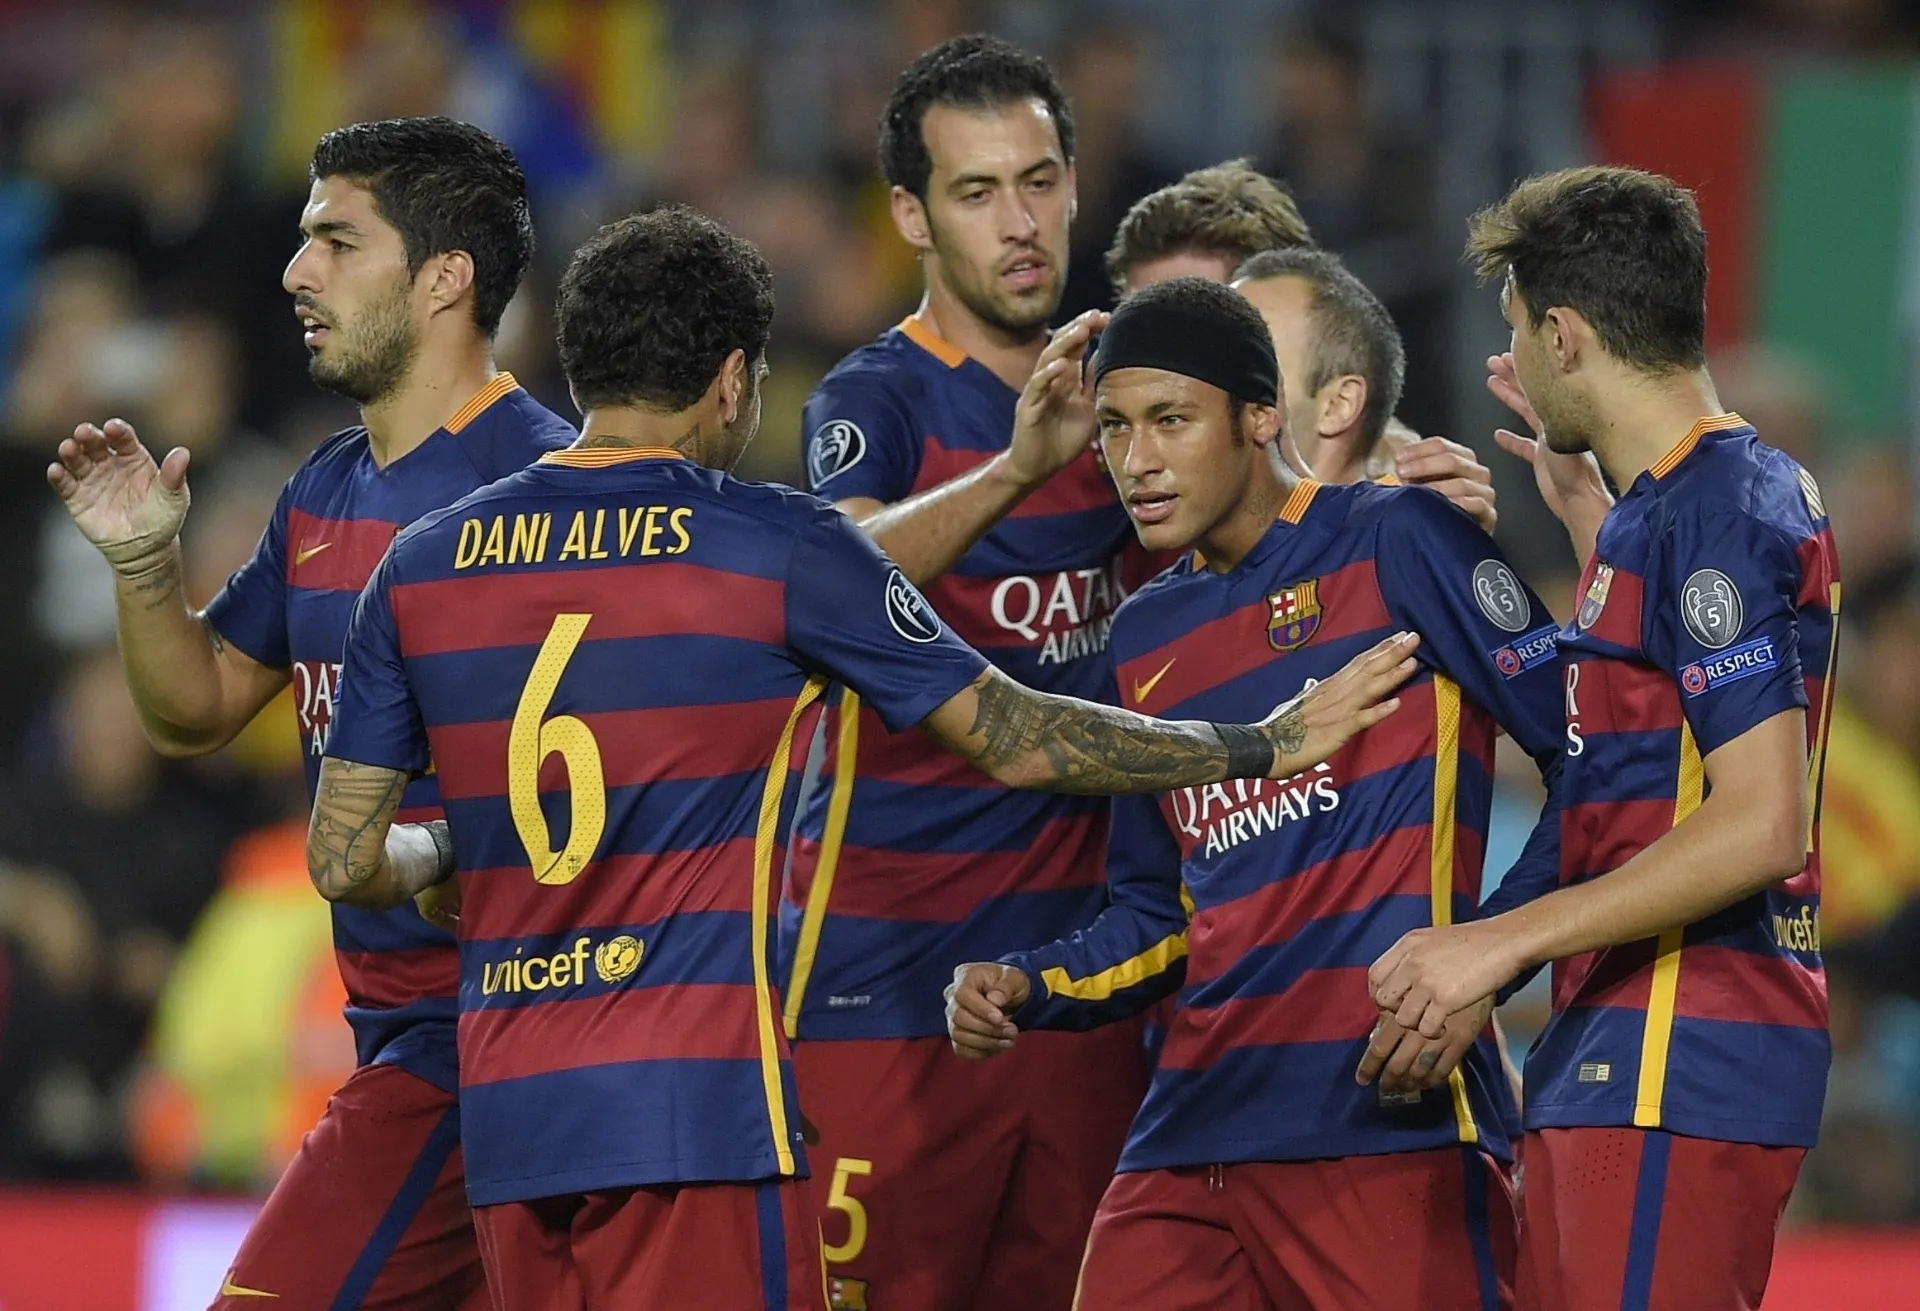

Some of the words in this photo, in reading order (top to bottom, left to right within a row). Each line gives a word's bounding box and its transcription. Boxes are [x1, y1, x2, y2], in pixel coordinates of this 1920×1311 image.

[454, 512, 551, 570] DANI
[558, 505, 693, 562] ALVES
[1500, 593, 1514, 612] 5
[1707, 606, 1721, 628] 5
[1705, 644, 1773, 681] RESPECT
[508, 613, 606, 885] 6
[1205, 776, 1340, 860] AIRWAYS
[482, 936, 592, 996] unicef
[824, 1157, 872, 1263] 5
